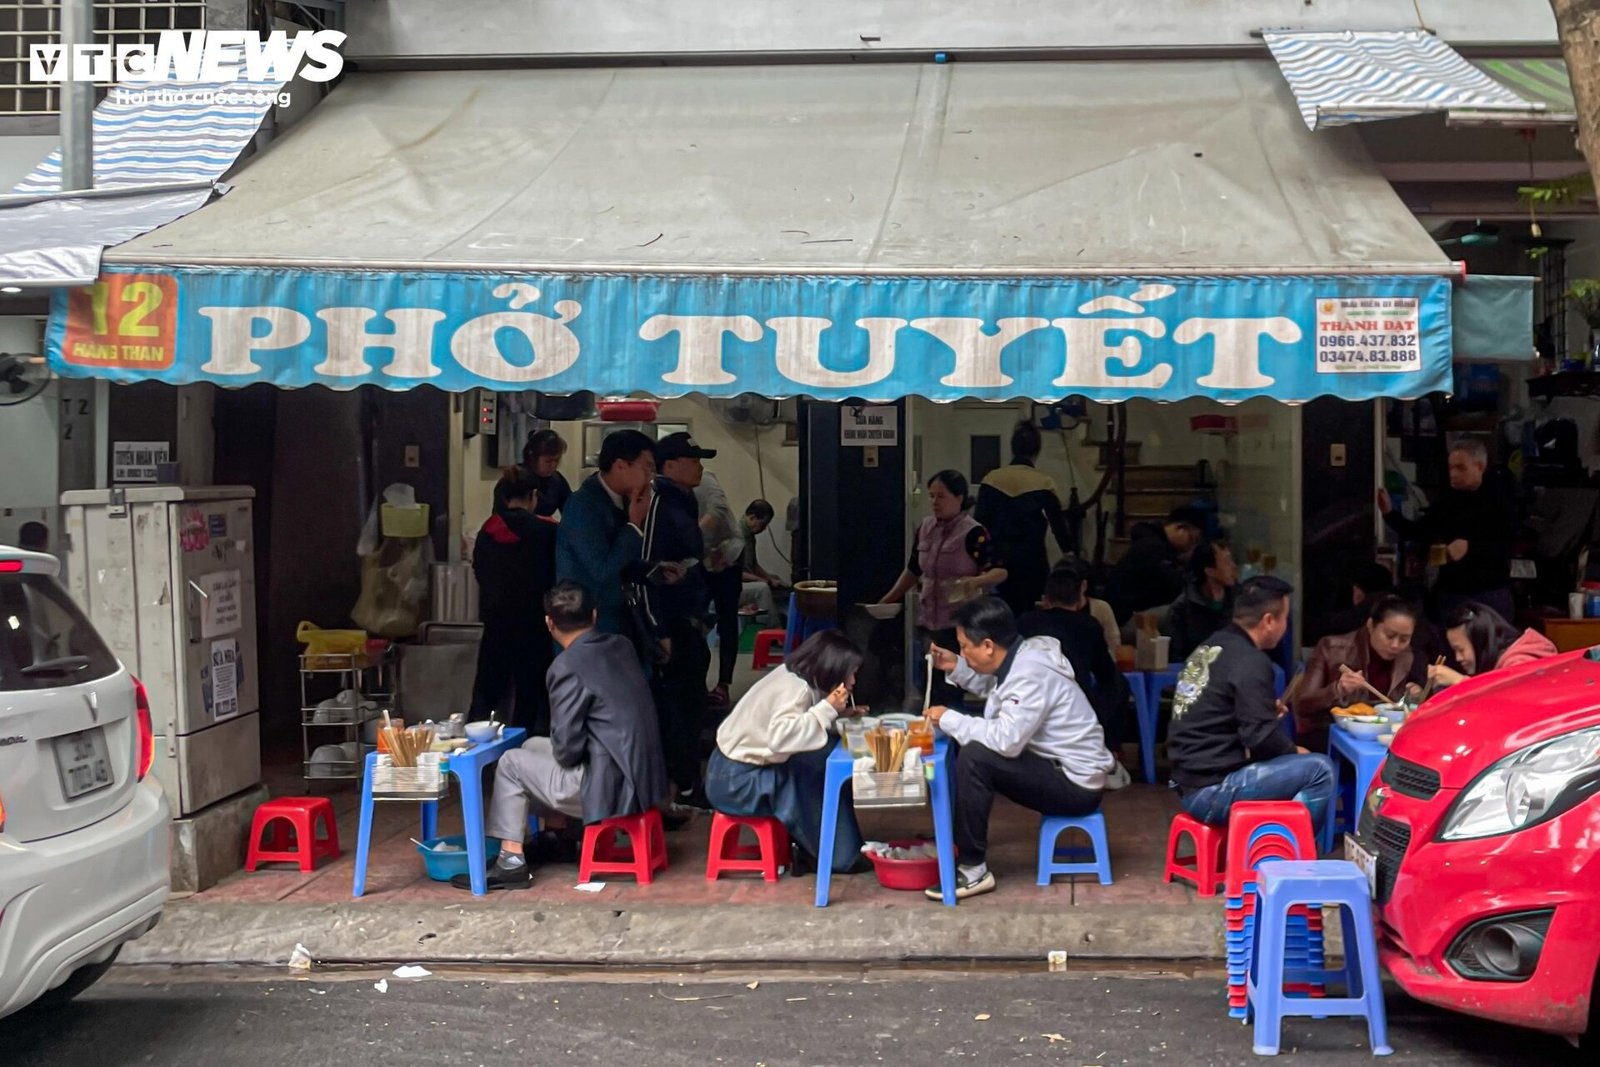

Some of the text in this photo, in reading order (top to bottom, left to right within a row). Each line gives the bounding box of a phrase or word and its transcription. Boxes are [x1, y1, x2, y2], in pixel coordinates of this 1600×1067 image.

[84, 281, 163, 337] 12
[198, 282, 1303, 390] PHỞ TUYẾT
[1319, 334, 1416, 348] 0966.437.832
[1319, 350, 1417, 363] 03474.83.888
